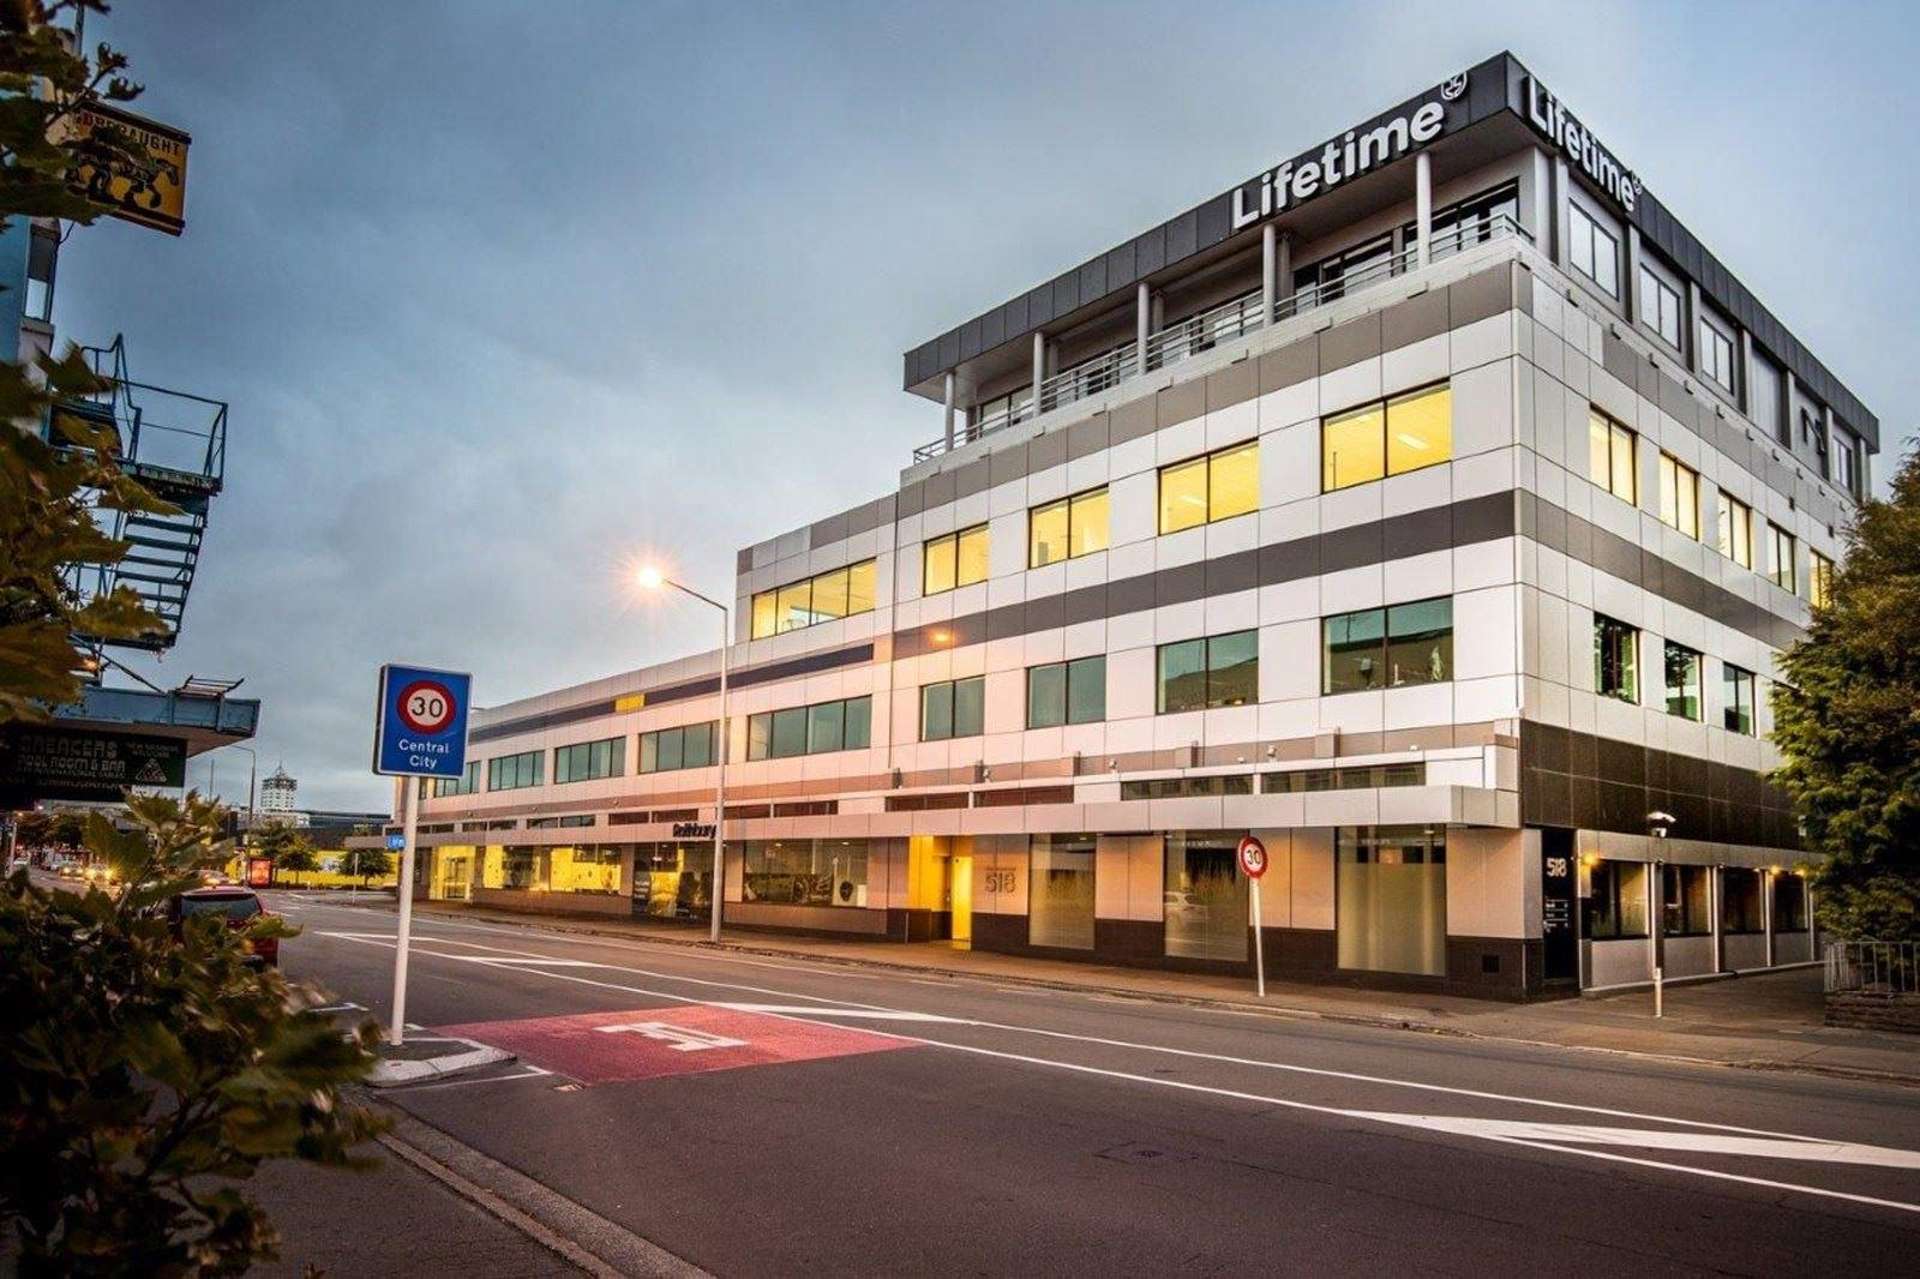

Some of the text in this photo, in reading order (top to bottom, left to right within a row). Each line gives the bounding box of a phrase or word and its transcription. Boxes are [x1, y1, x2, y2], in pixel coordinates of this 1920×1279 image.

[1529, 75, 1635, 212] Lifetime
[1233, 101, 1445, 230] Lifetime
[411, 696, 444, 719] 30
[398, 739, 449, 755] Central
[17, 753, 48, 767] POOL
[51, 755, 88, 770] ROOM
[409, 755, 438, 769] City
[1246, 849, 1261, 865] 30
[1546, 857, 1567, 877] 518
[985, 872, 1016, 893] 518
